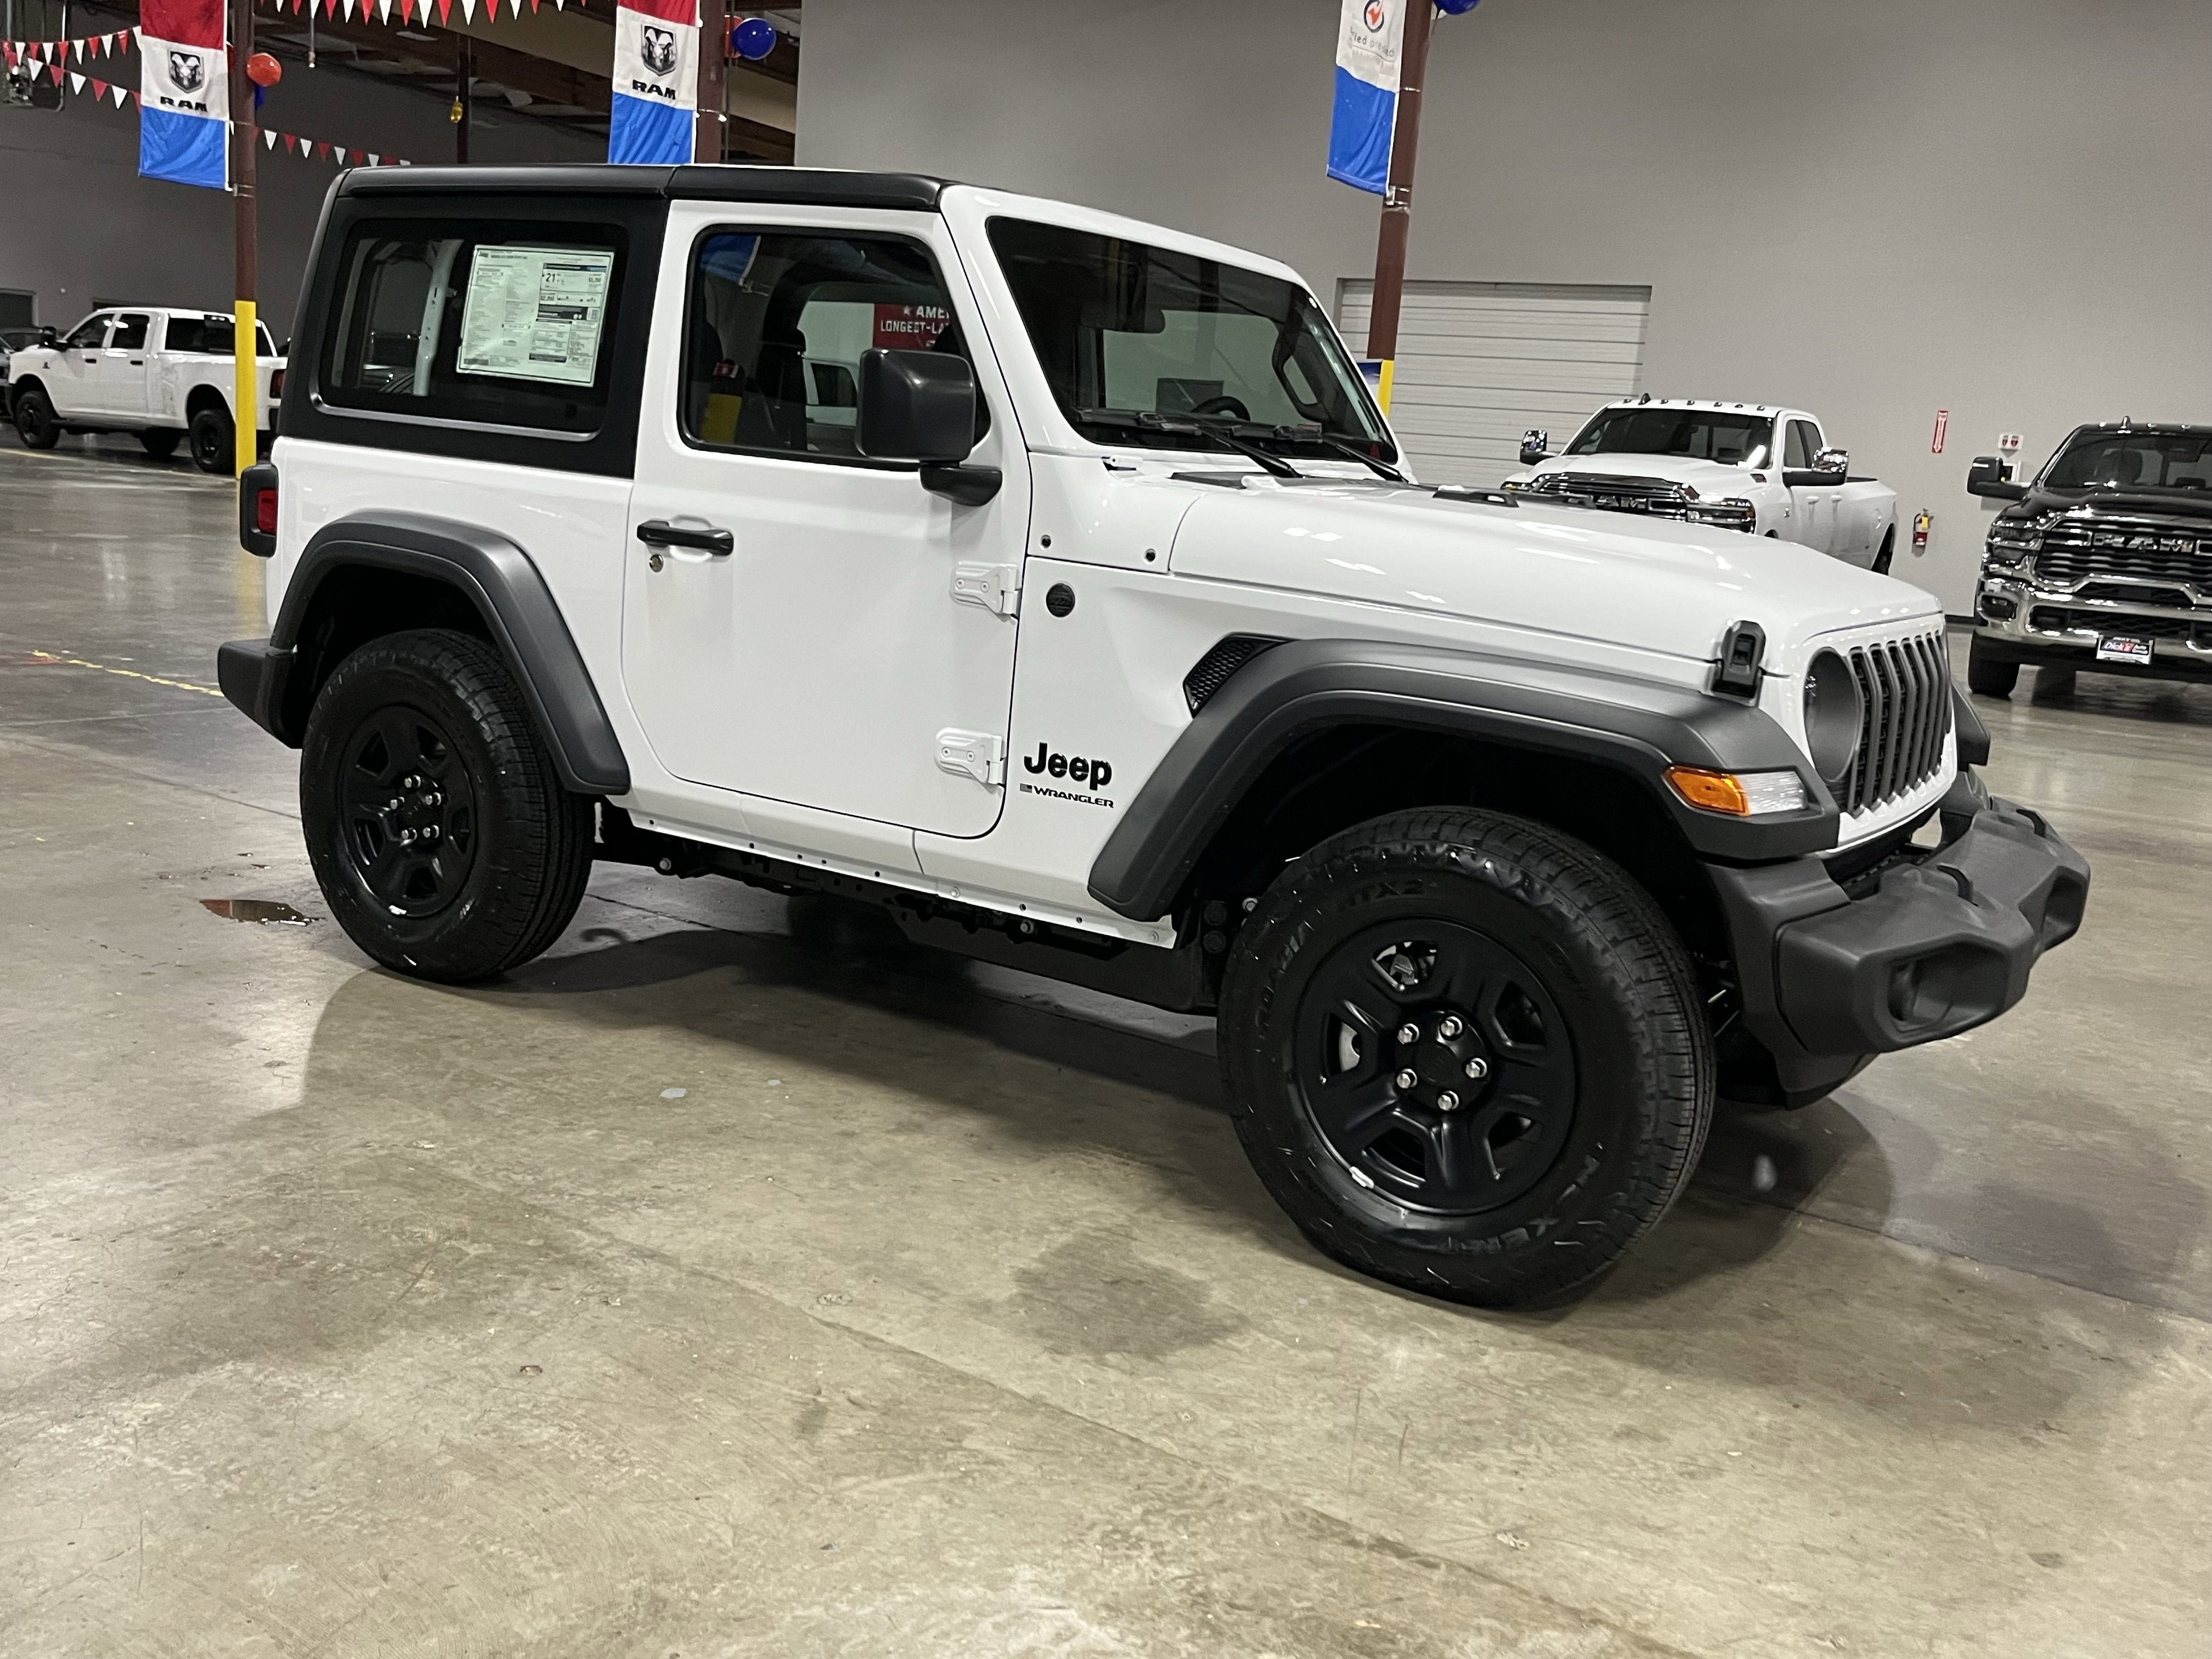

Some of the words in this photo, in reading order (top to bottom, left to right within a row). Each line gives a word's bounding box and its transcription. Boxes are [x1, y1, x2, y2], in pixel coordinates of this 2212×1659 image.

[632, 80, 676, 100] RAM
[160, 96, 208, 112] RAM
[545, 273, 556, 283] 21
[2093, 532, 2193, 552] RAM
[1024, 742, 1112, 791] Jeep
[1033, 785, 1114, 809] WRANGLER
